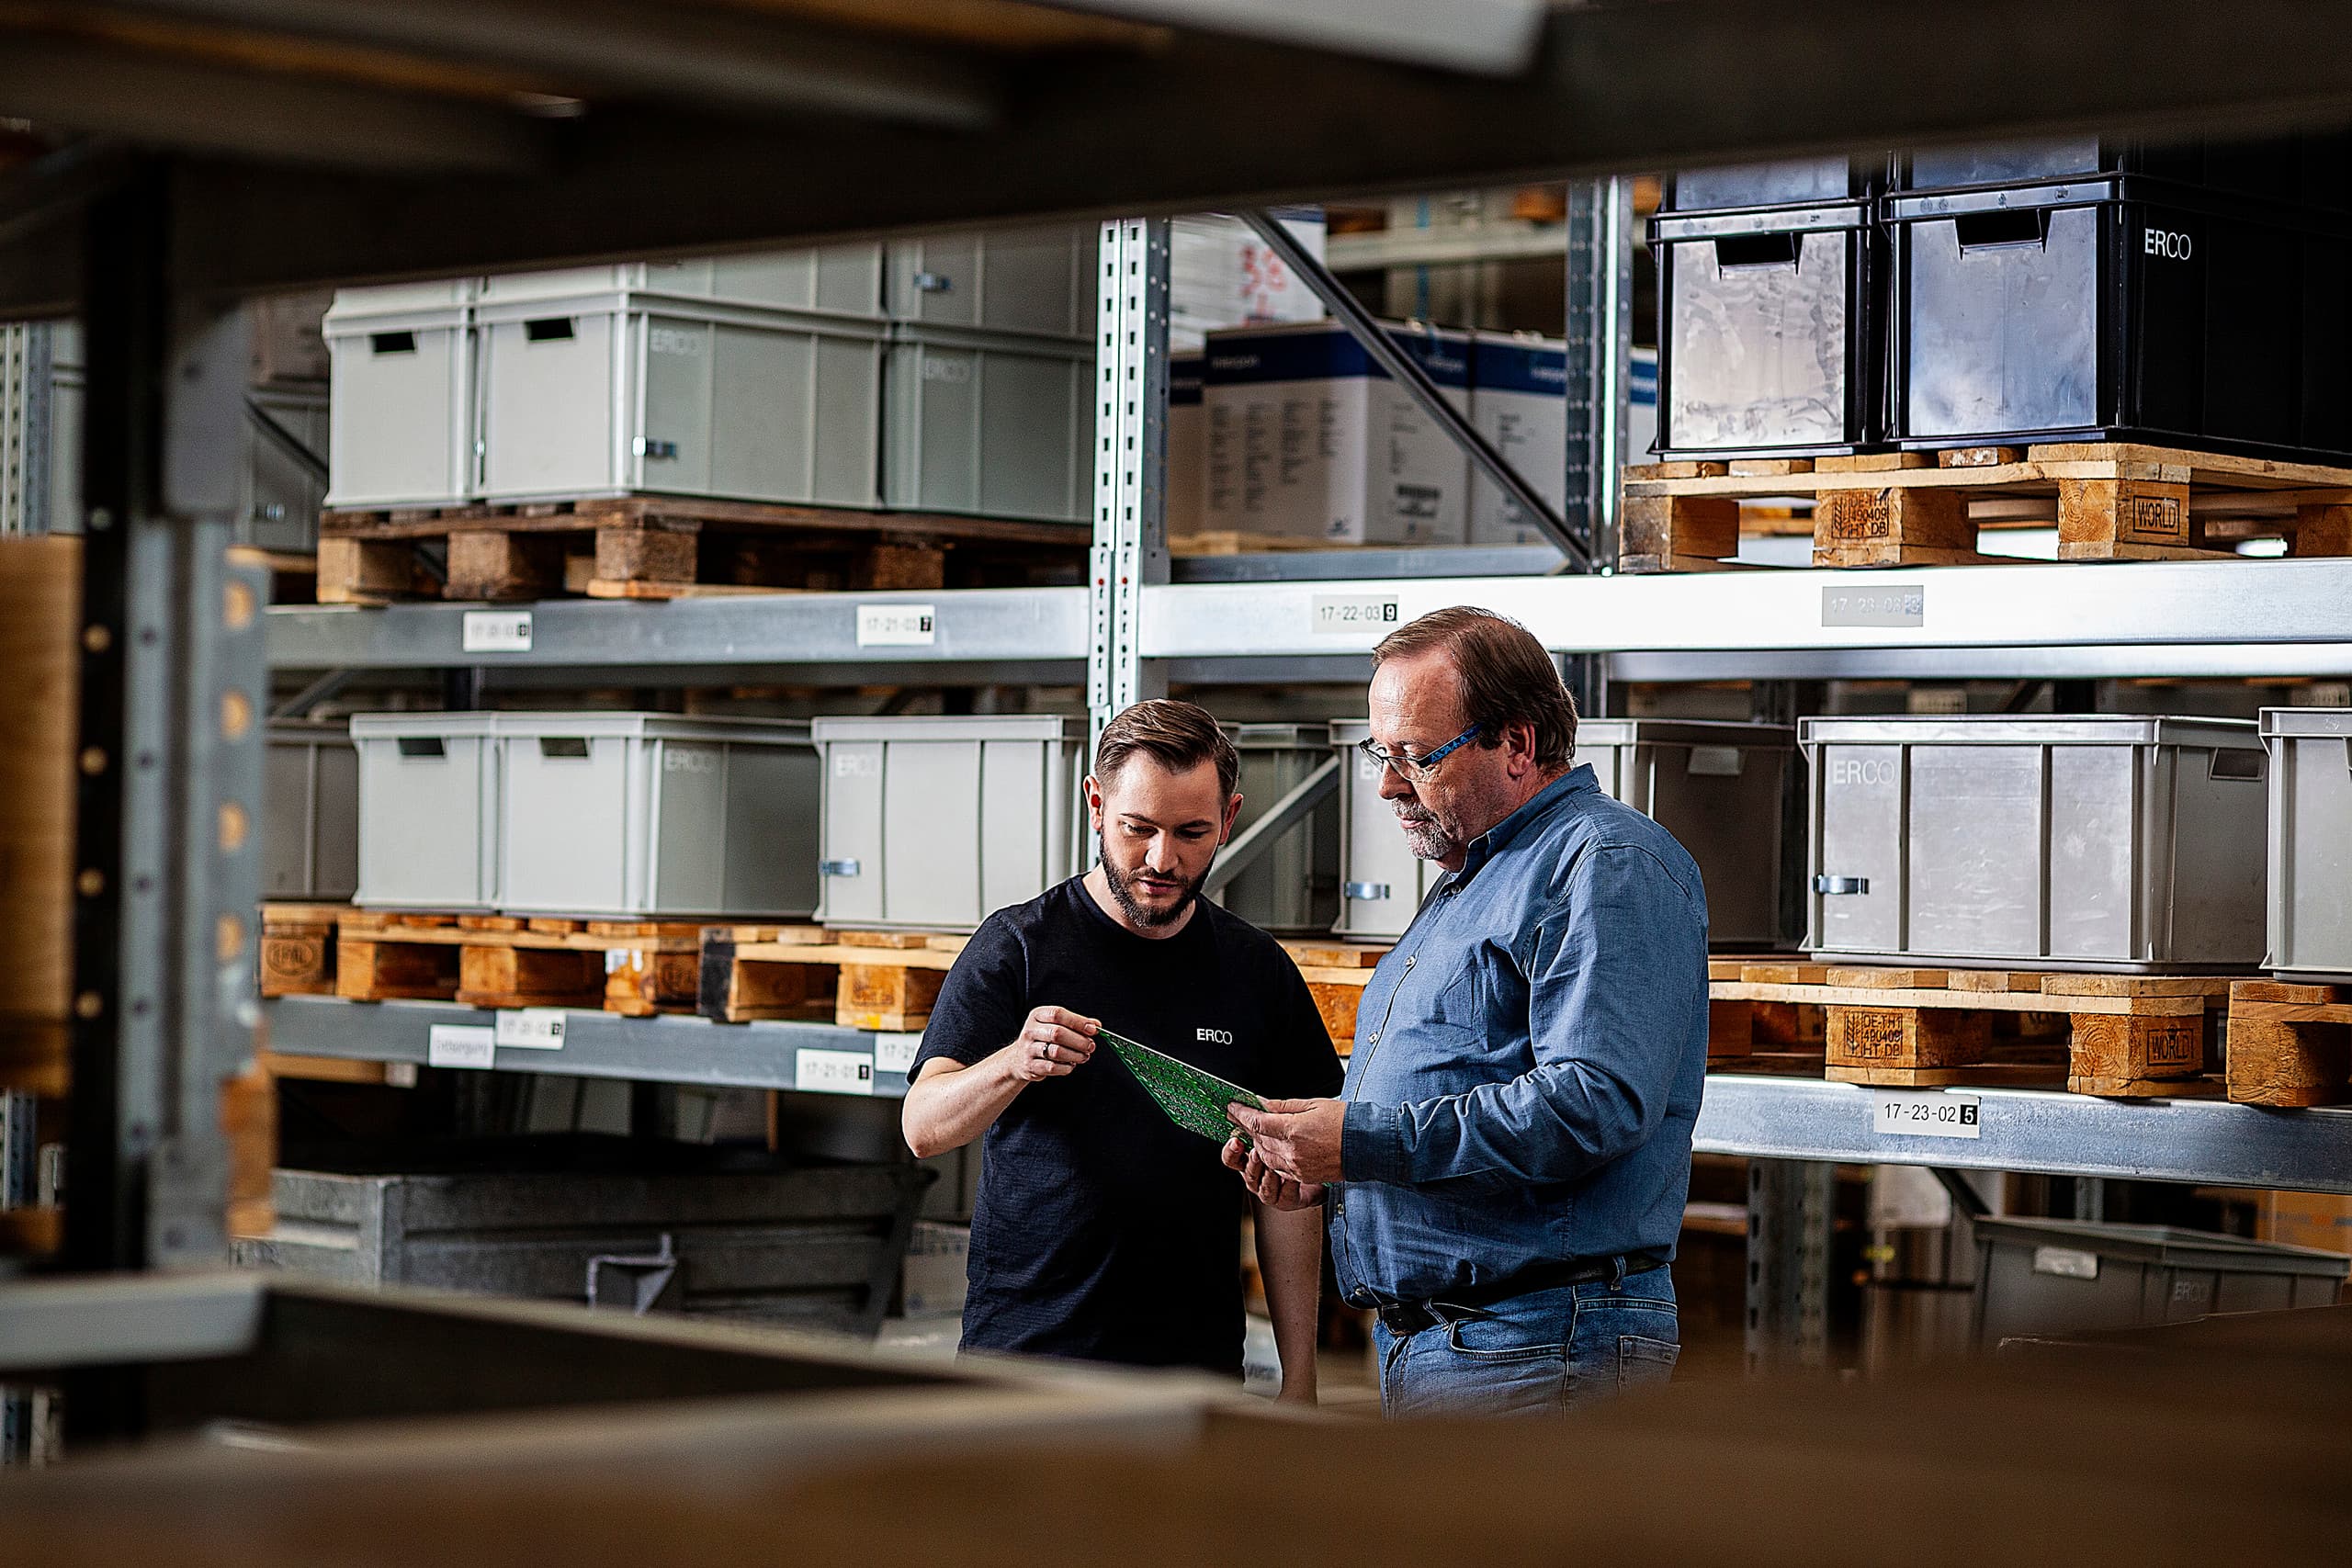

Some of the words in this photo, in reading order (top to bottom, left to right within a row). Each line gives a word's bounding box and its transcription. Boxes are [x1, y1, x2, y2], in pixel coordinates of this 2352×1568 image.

[2144, 228, 2192, 261] ERCO
[2138, 501, 2177, 528] WORLD
[1871, 521, 1886, 535] DB
[1321, 605, 1380, 621] 17-22-03
[1385, 604, 1396, 621] 9
[1833, 760, 1895, 784] ERCO
[1196, 1028, 1233, 1044] ERCO
[2152, 1034, 2190, 1060] WORLD
[1863, 1043, 1882, 1056] HT
[1885, 1043, 1901, 1056] DB
[1884, 1102, 1956, 1122] 17-23-02
[1962, 1106, 1976, 1124] 5
